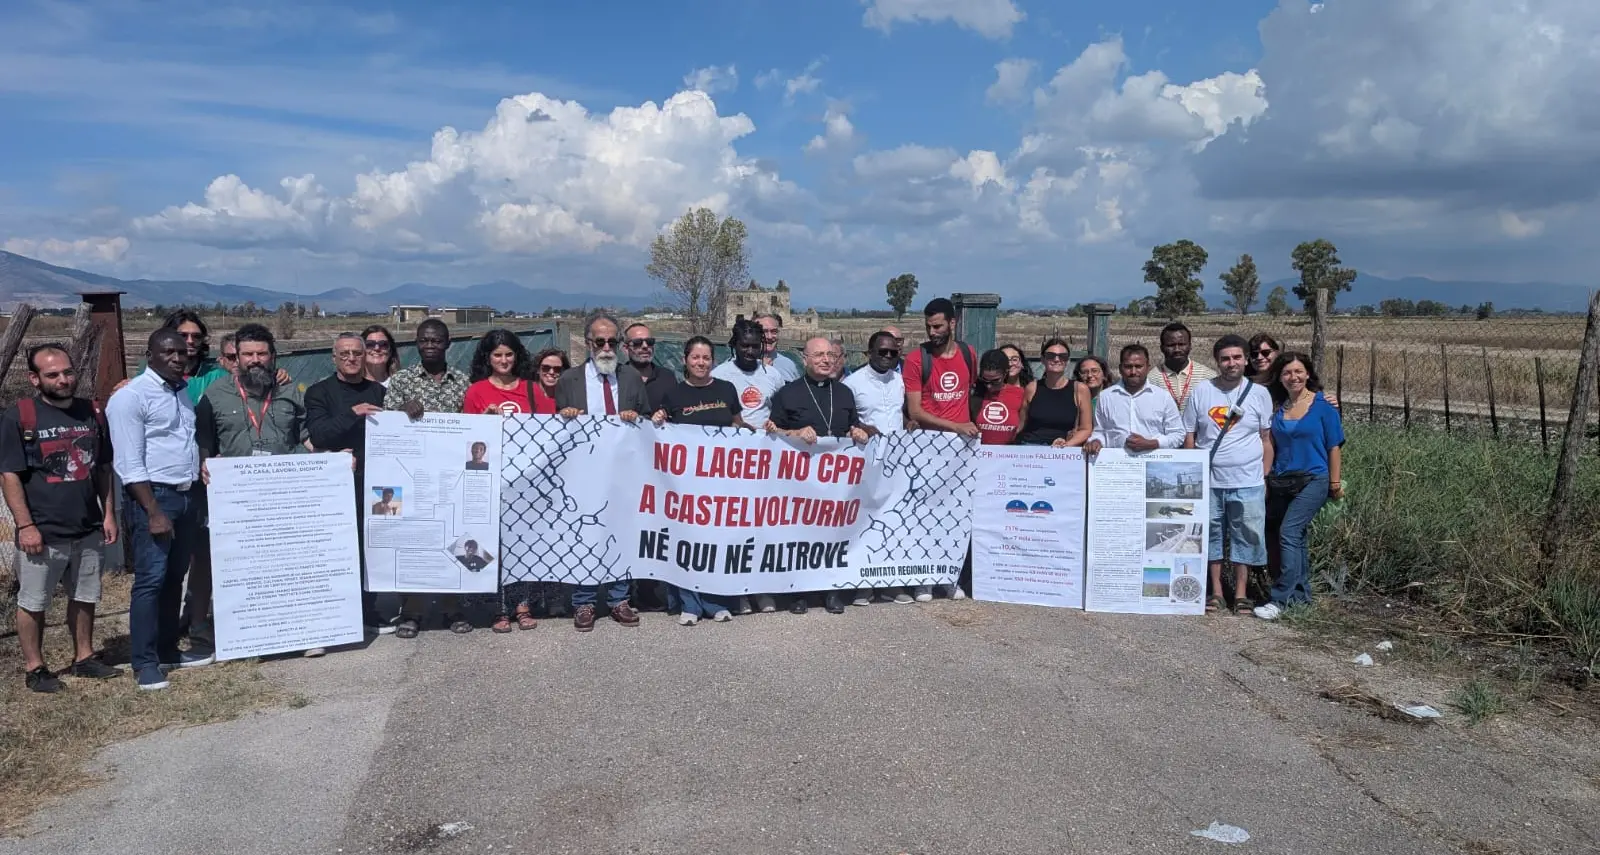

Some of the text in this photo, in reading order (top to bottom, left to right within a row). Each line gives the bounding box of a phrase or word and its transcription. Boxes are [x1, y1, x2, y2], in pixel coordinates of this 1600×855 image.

[653, 441, 866, 486] NO LAGER NO CPR
[638, 483, 656, 515] A
[638, 527, 850, 575] NÉ QUI NÉ ALTROVE
[860, 566, 896, 578] COMITATO
[897, 564, 935, 576] REGIONALE
[936, 564, 947, 574] NO
